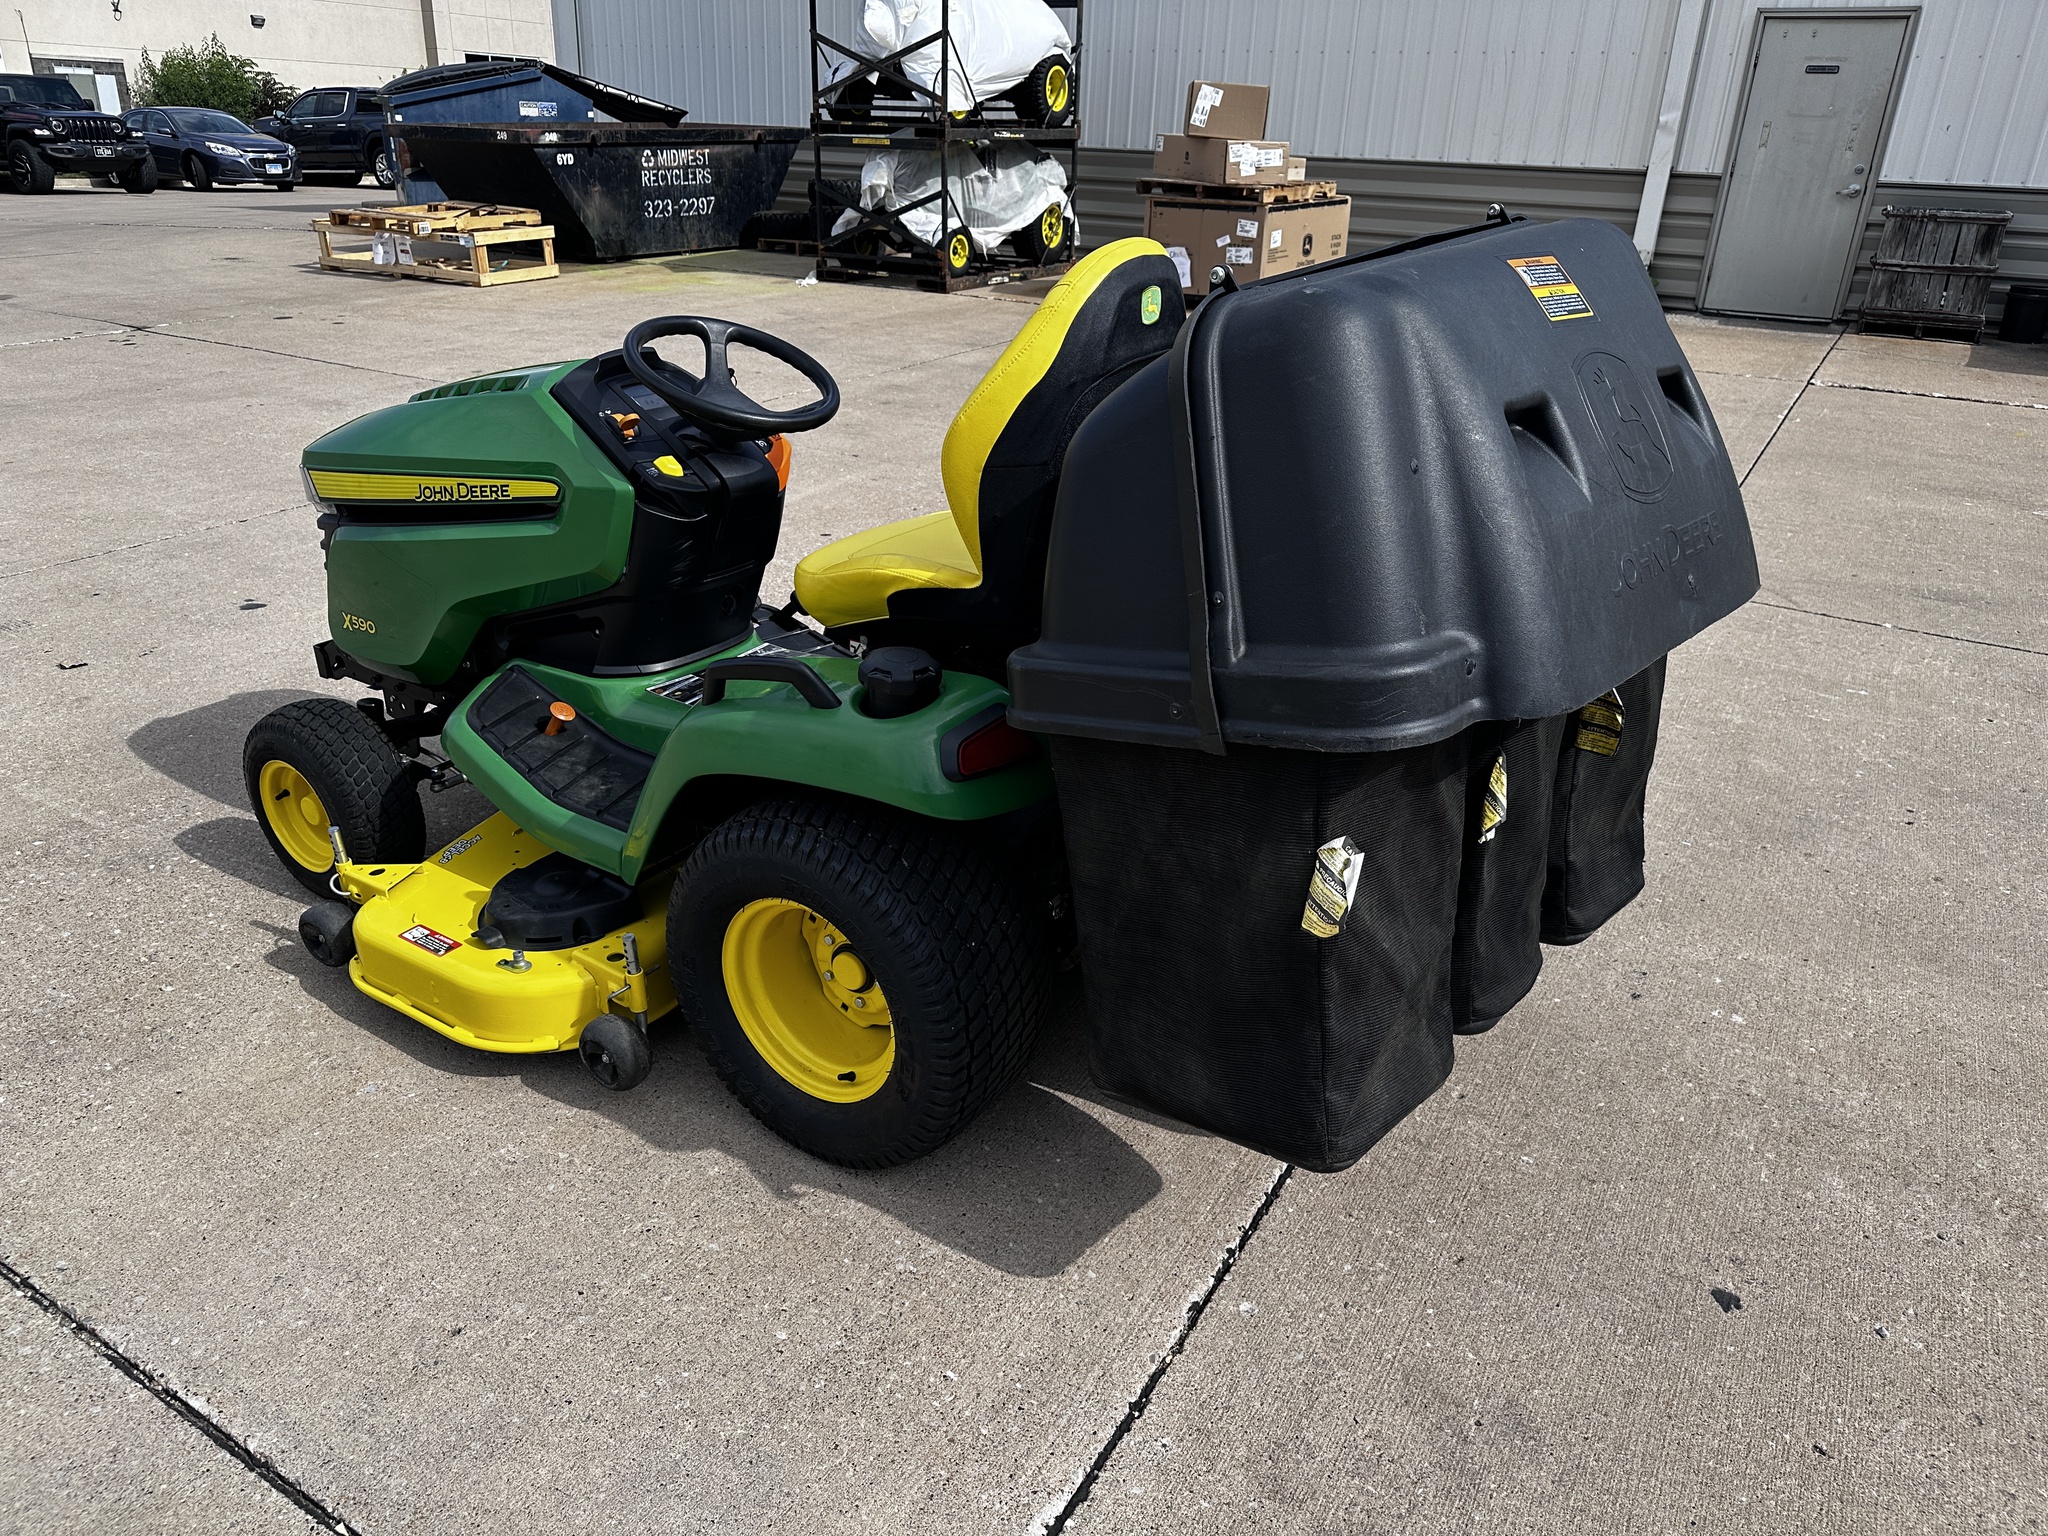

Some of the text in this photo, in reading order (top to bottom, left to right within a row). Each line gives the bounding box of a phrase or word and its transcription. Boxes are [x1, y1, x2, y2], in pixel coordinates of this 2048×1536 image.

[496, 131, 508, 140] 249
[544, 132, 558, 142] 249
[556, 153, 574, 165] 6YD
[657, 149, 710, 167] MIDWEST
[641, 168, 712, 187] RECYCLERS
[644, 196, 715, 218] 323-2297
[415, 482, 511, 501] JOHN DEERE
[1611, 510, 1724, 598] JOHN DEERE
[341, 611, 376, 635] X590
[1319, 867, 1347, 897] PRECAUCIO
